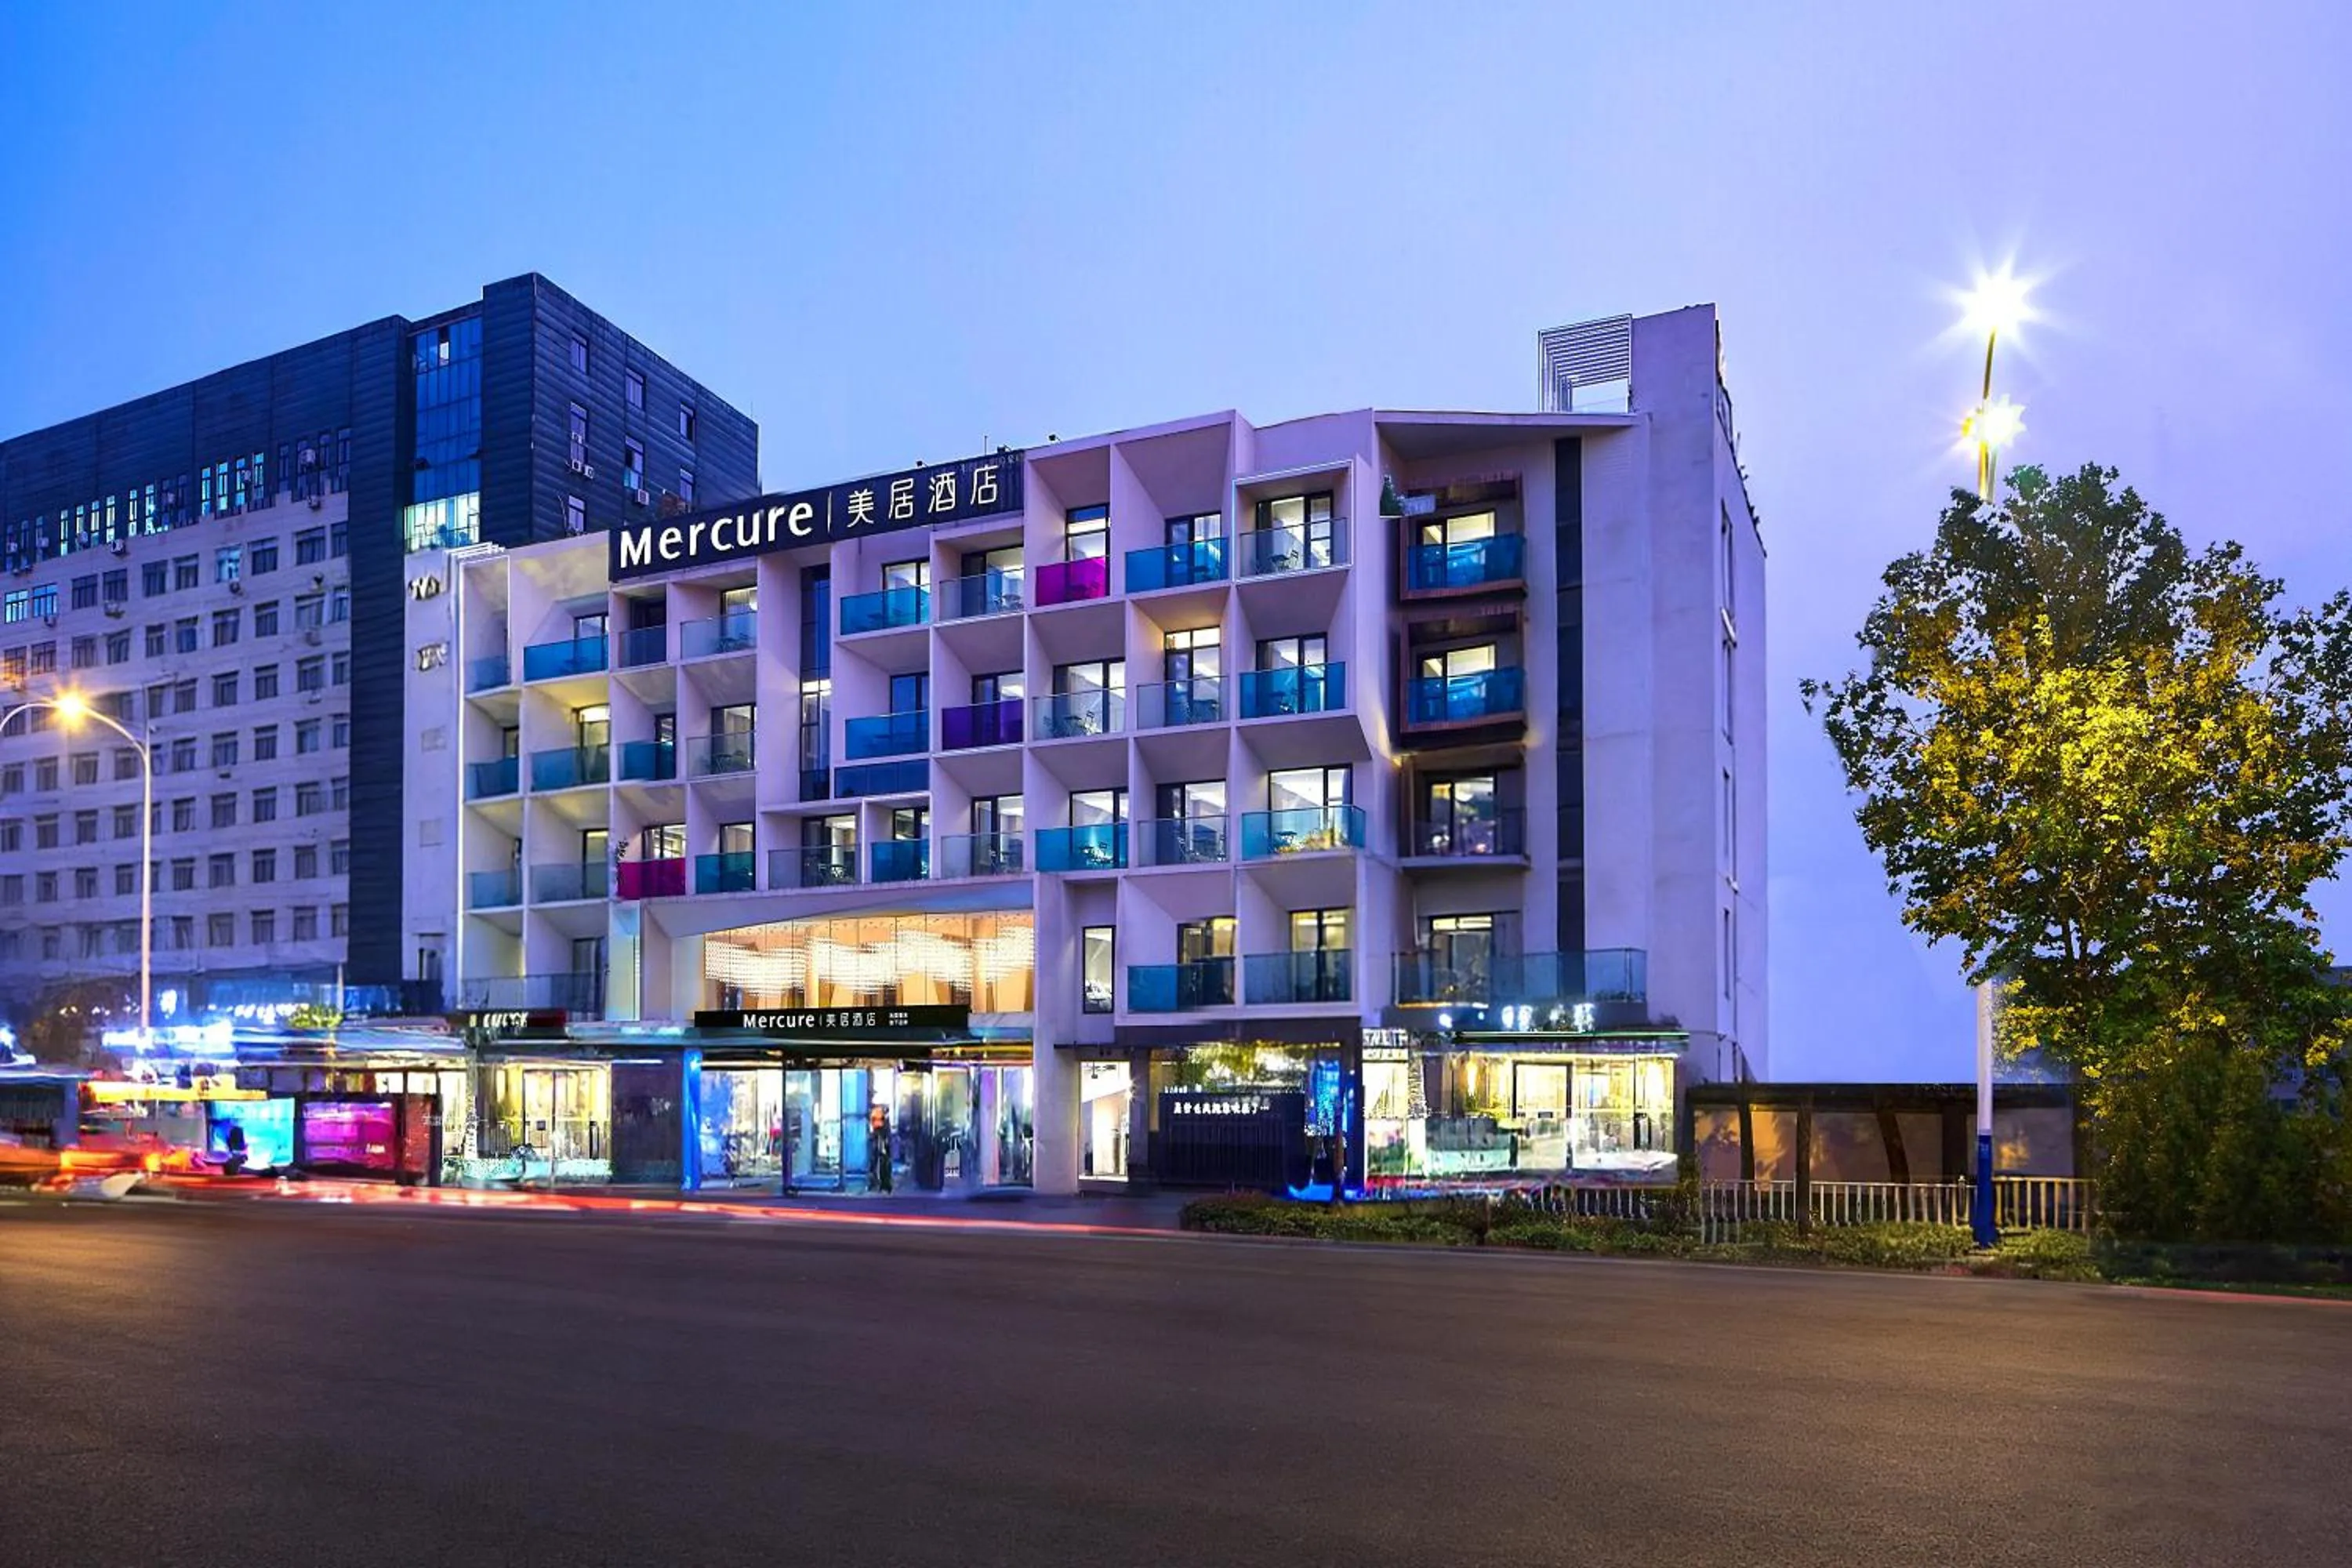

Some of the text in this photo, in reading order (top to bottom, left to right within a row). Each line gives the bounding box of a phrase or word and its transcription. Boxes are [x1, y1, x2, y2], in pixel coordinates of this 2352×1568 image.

[620, 465, 999, 568] Mercure 美居酒店
[743, 1014, 815, 1029] Mercure
